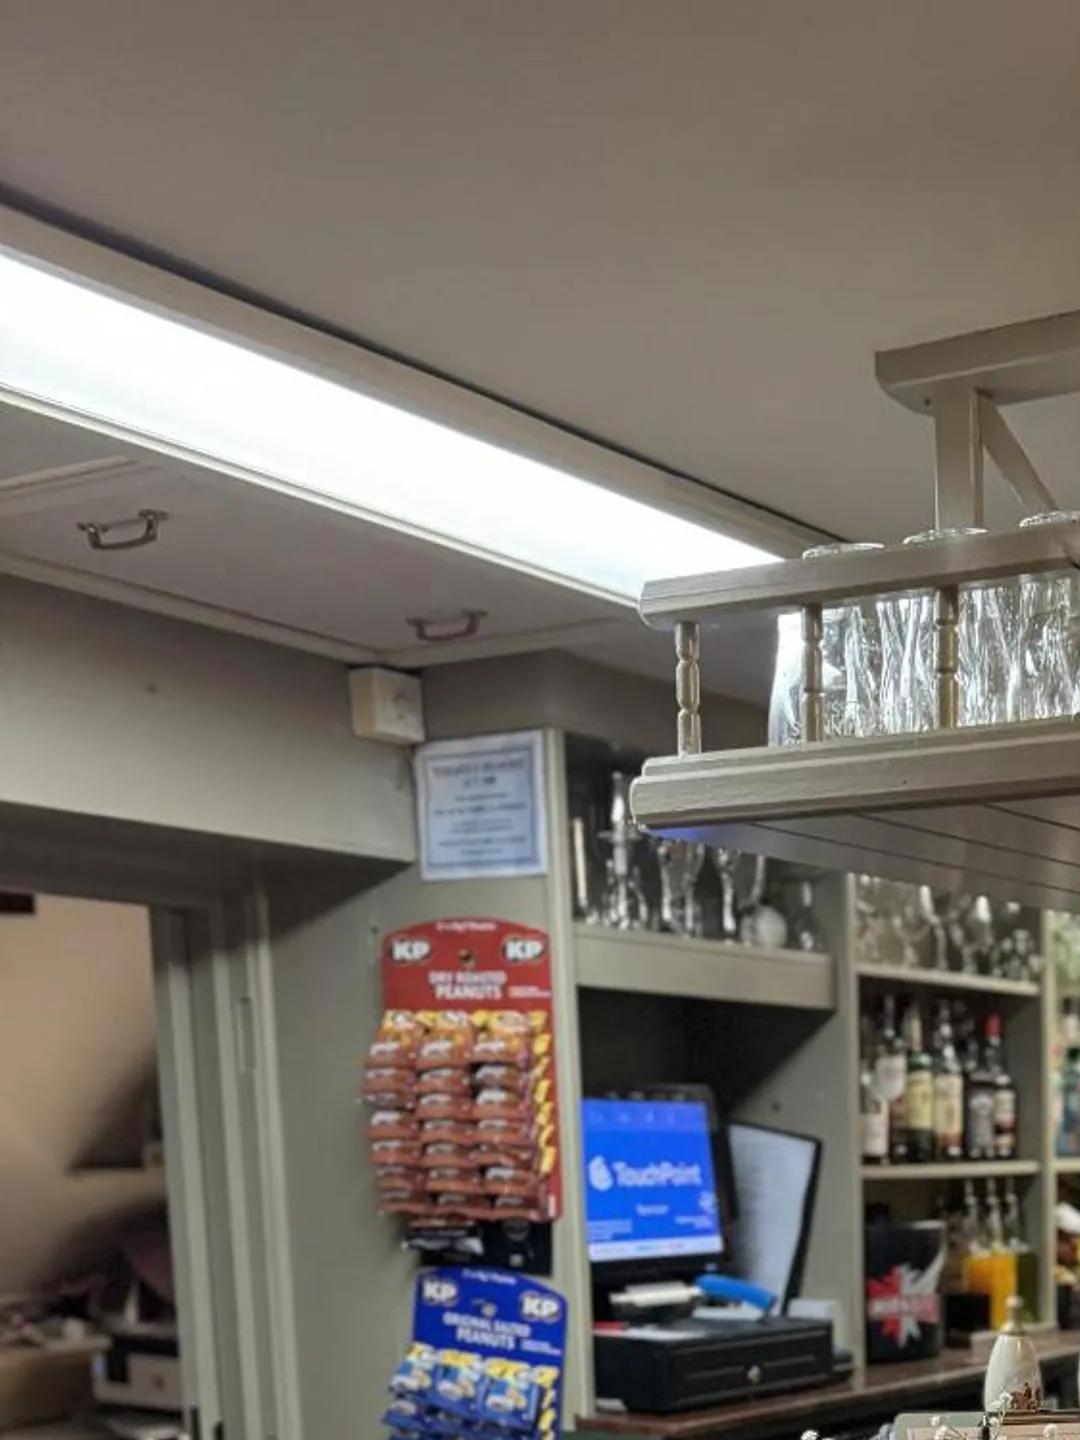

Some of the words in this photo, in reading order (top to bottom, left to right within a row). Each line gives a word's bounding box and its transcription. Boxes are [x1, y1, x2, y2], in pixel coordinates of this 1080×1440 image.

[391, 940, 430, 961] KP
[506, 939, 543, 960] KP
[435, 984, 503, 1000] PEANUTS
[423, 1279, 458, 1302] KP
[522, 1296, 559, 1319] KP
[456, 1326, 516, 1350] PEANUTS
